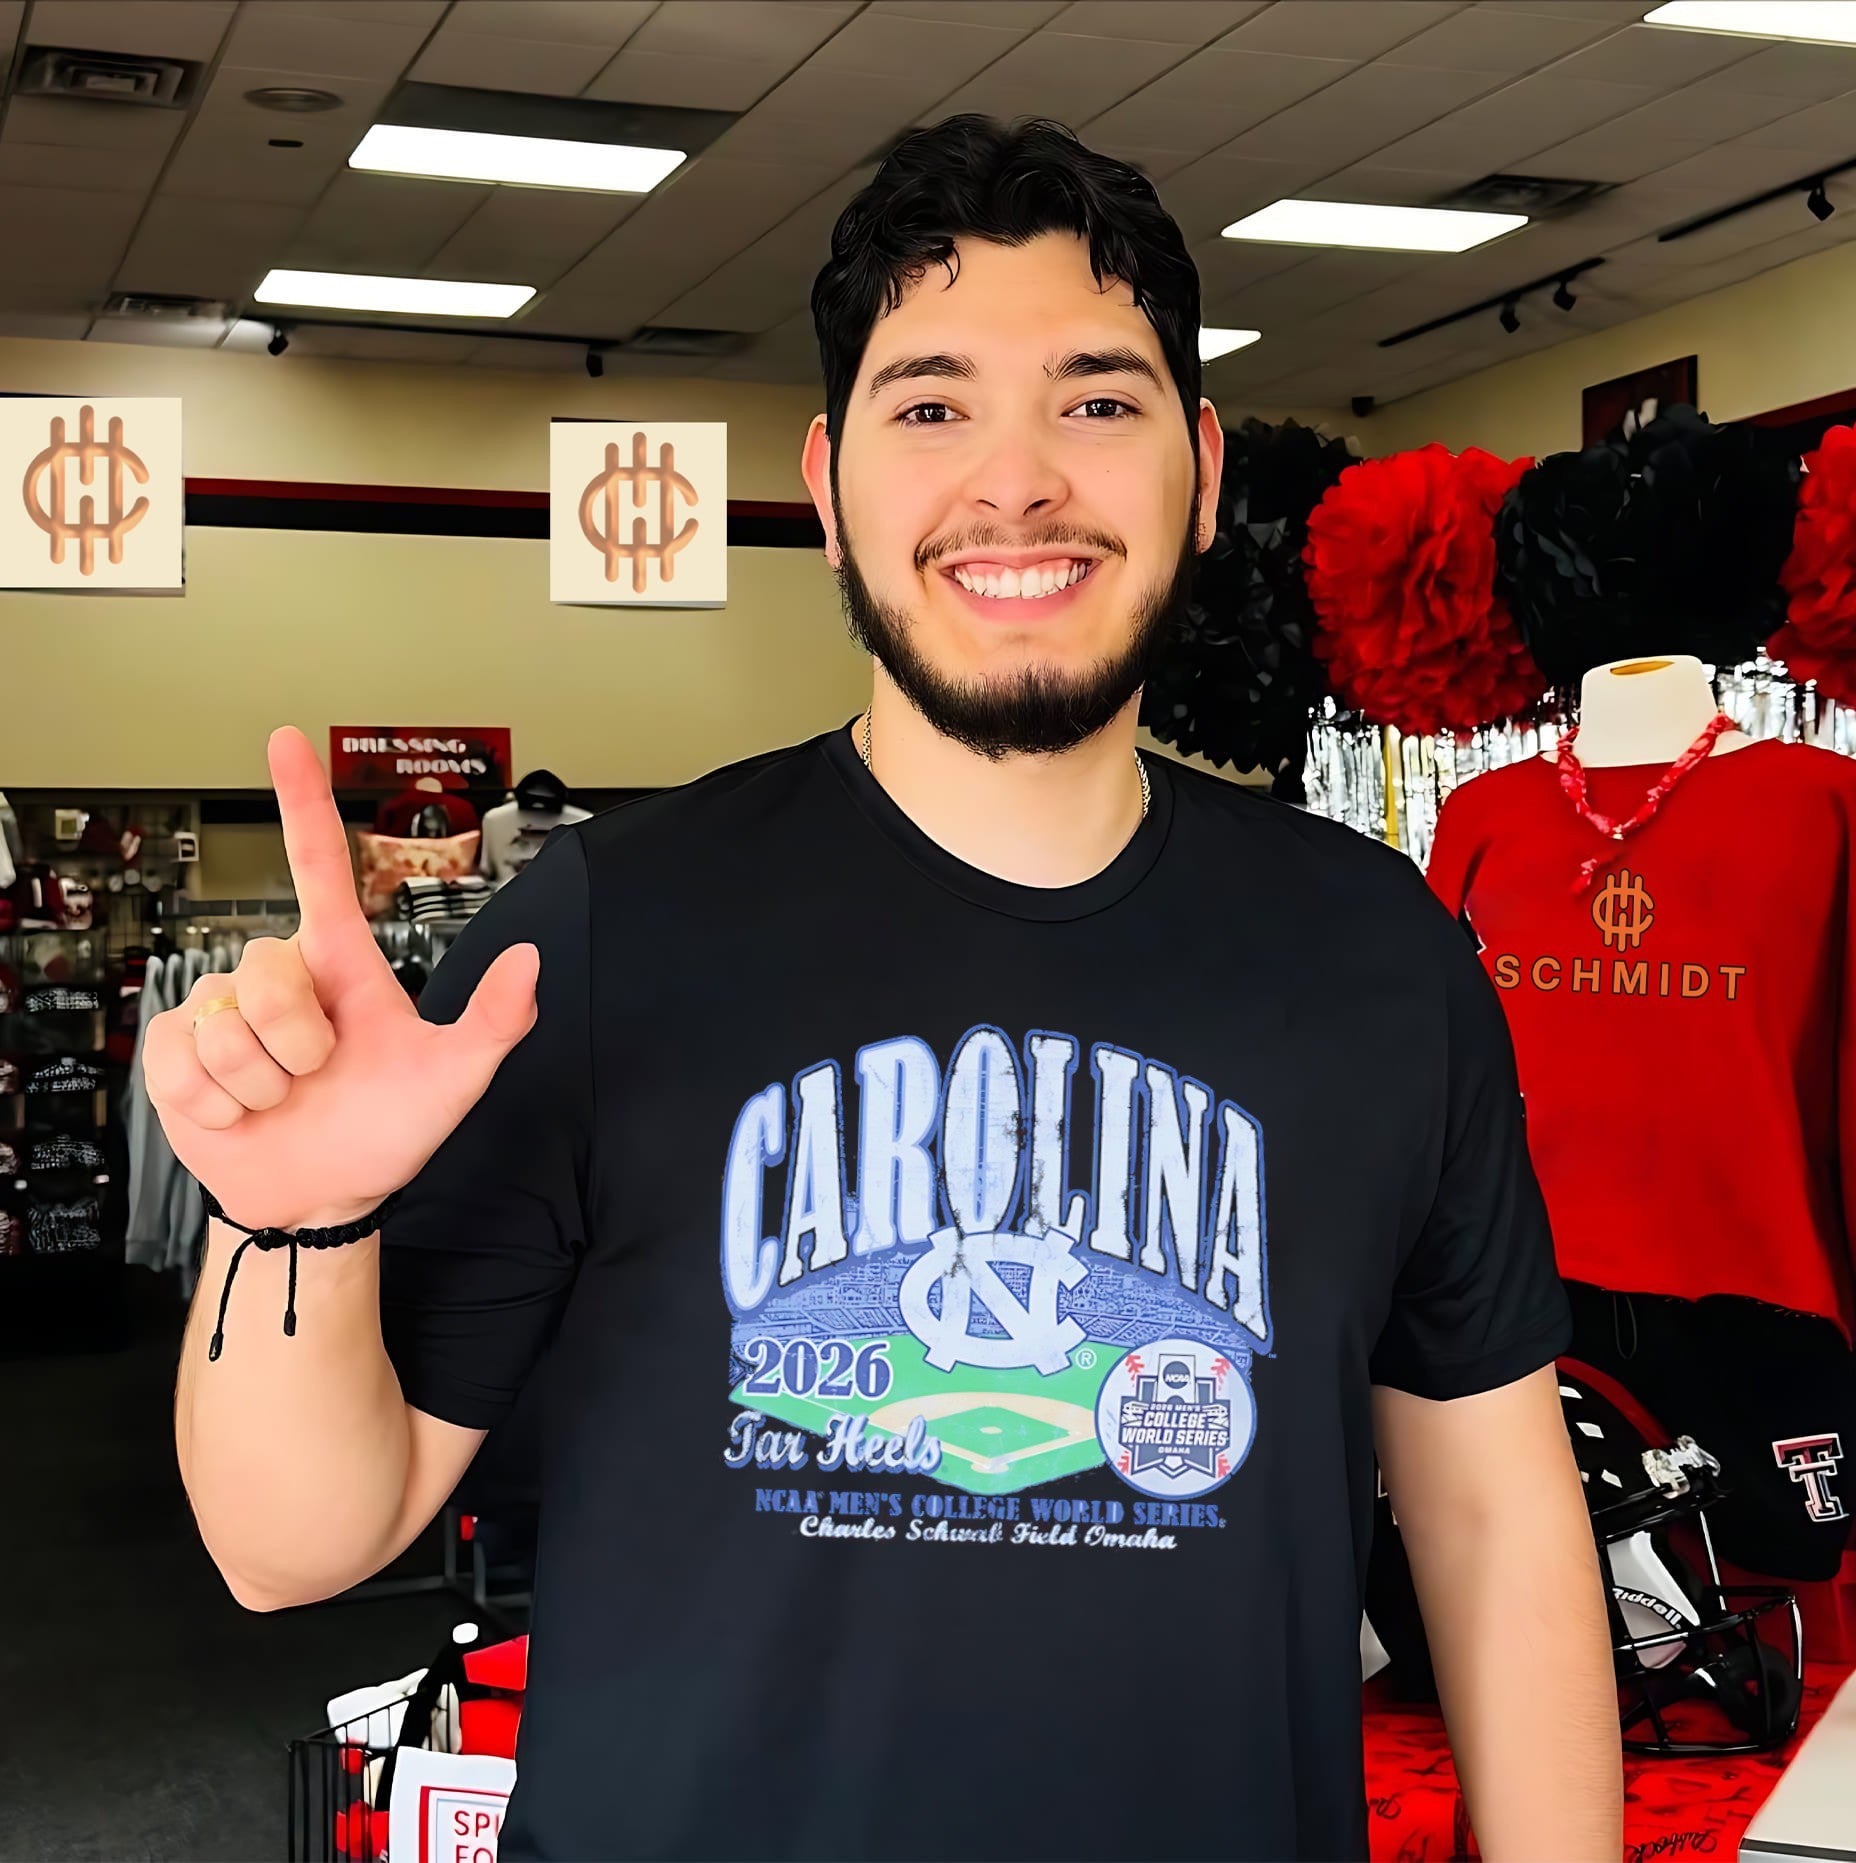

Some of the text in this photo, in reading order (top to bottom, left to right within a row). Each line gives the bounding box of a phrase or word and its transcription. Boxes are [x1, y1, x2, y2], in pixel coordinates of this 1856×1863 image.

[342, 737, 466, 753] DRESSING
[396, 758, 486, 774] ROOMS
[1494, 953, 1746, 1000] SCHMIDT
[721, 1023, 1273, 1354] CAROLINA
[743, 1336, 893, 1401] 2026
[1164, 1372, 1191, 1384] NCAA
[1143, 1411, 1207, 1429] COLLEGE
[723, 1410, 942, 1474] Tar Heels
[1121, 1428, 1229, 1446] WORLD SERIES
[1157, 1446, 1191, 1455] OMAHA
[828, 1491, 903, 1517] MEN'S
[910, 1494, 1021, 1520] COLLEGE
[1030, 1498, 1124, 1524] WORLD
[800, 1515, 1178, 1549] Charles Schwab Field Omaha
